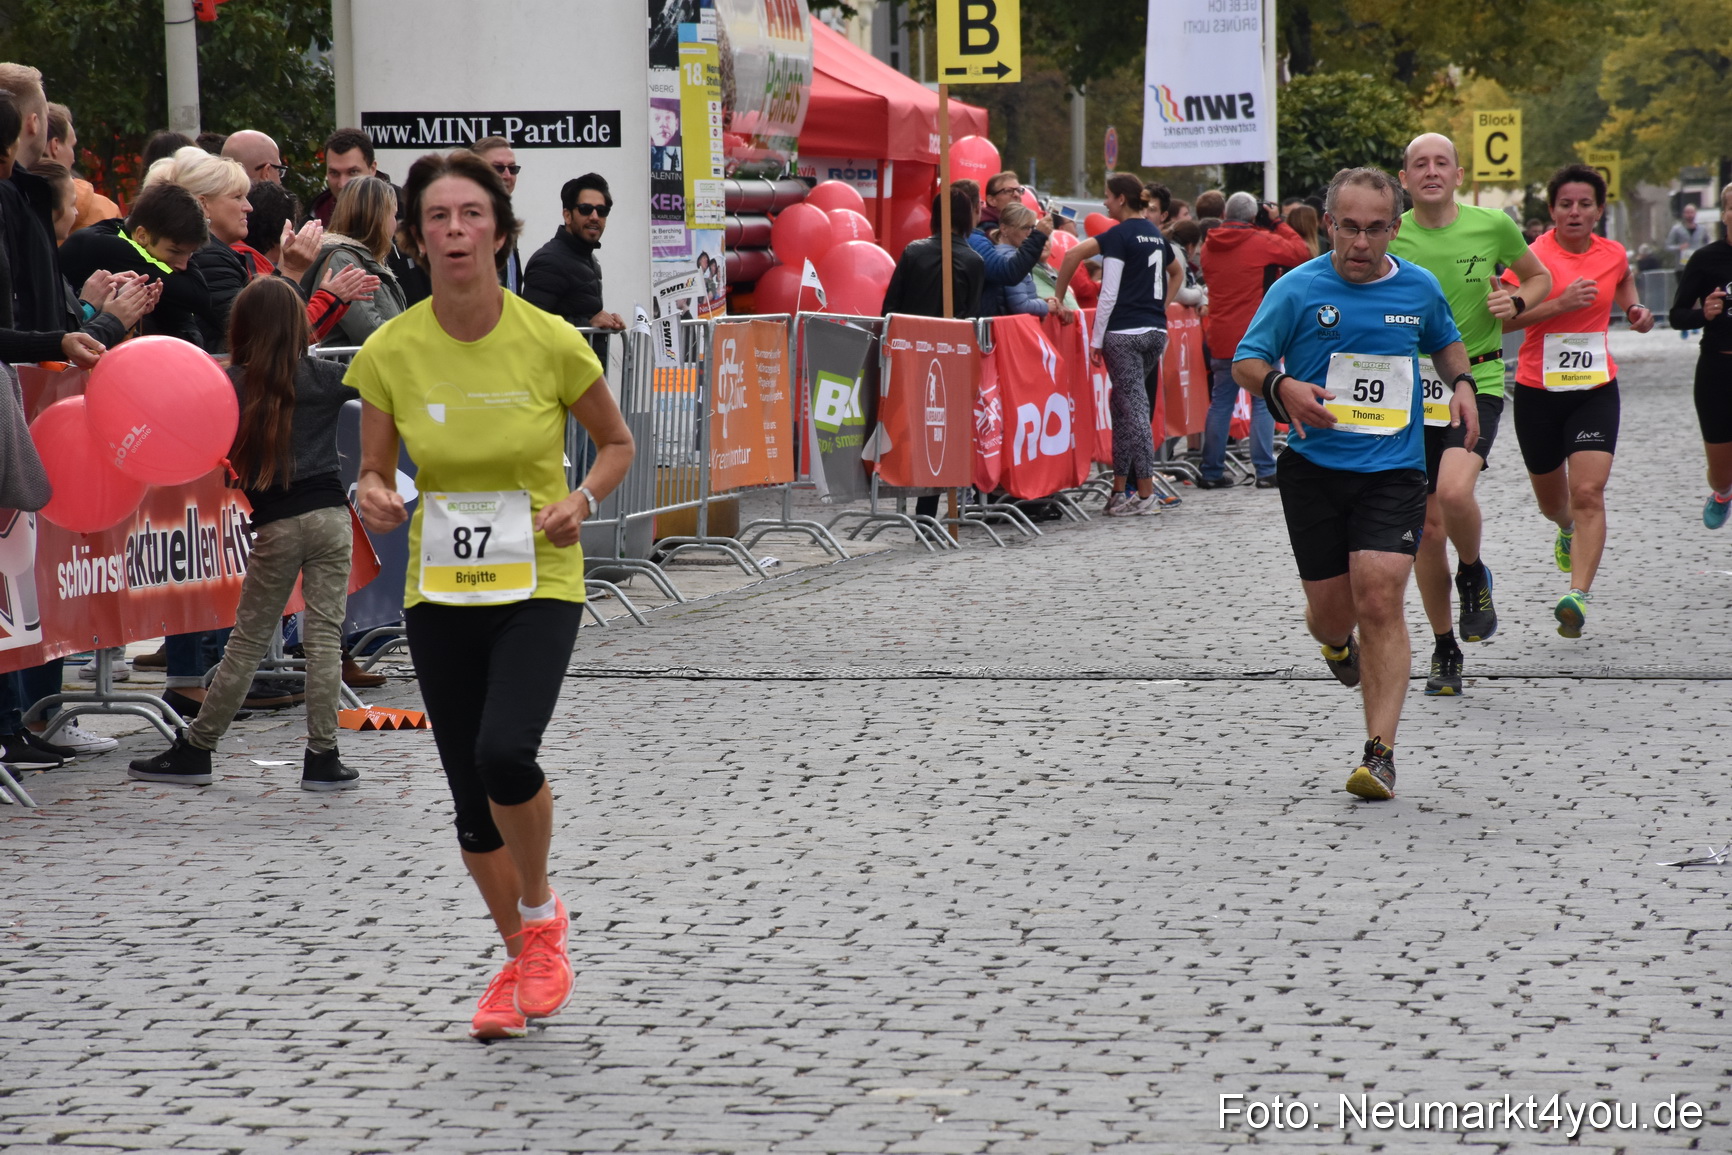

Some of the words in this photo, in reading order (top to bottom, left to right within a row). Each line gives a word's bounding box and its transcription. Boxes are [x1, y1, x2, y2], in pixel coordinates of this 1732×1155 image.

[959, 0, 999, 55] B
[683, 62, 707, 86] 18.
[1479, 113, 1515, 127] Block
[363, 114, 611, 144] www.MINI-Partl.de
[1485, 131, 1509, 166] C
[1588, 153, 1616, 164] Block
[658, 228, 682, 236] Berching
[1136, 235, 1149, 243] The
[1148, 249, 1163, 301] 1
[659, 282, 684, 297] swn
[1384, 314, 1421, 325] BOCK
[663, 320, 672, 348] swn
[1361, 361, 1391, 370] BOCK
[1559, 350, 1593, 369] 270
[1561, 374, 1592, 382] Marianne
[1353, 378, 1385, 403] 59
[1351, 409, 1385, 421] Thomas
[459, 501, 497, 512] BOCK
[125, 506, 221, 590] aktuellen
[453, 526, 493, 560] 87
[456, 571, 497, 586] Brigitte
